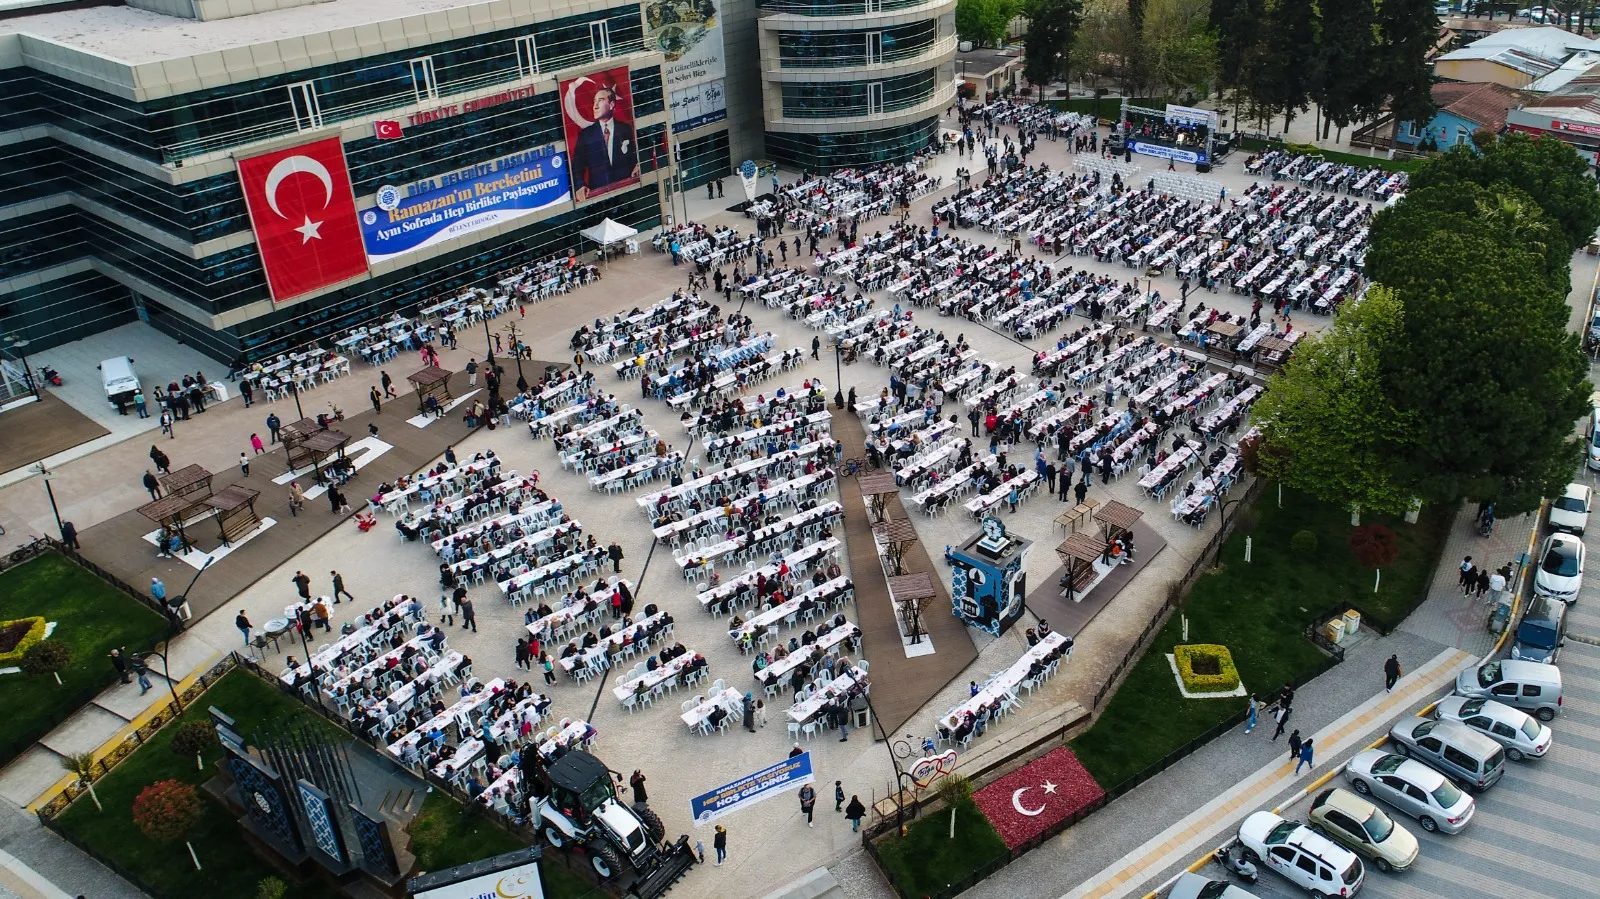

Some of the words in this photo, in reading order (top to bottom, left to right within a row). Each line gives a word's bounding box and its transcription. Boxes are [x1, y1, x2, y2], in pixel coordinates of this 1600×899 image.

[408, 104, 458, 126] TÜRKİYE
[463, 84, 536, 114] CUMHURİYETİ
[388, 189, 472, 223] Ramazan'ın
[474, 164, 542, 196] Bereketini
[408, 179, 436, 197] BİGA
[442, 164, 493, 188] BELEDİYE
[497, 144, 556, 171] BAŞKANLIĞI
[376, 227, 402, 241] Aynı
[402, 212, 443, 233] Sofrada
[444, 207, 464, 220] Hep
[465, 195, 502, 212] Birlikte
[503, 178, 559, 200] Paylaşıyoruz
[703, 796, 720, 806] HEP
[720, 781, 756, 797] BİRLİKTE
[756, 762, 800, 783] YAŞIYORUZ
[716, 793, 740, 808] HOŞ
[741, 772, 790, 797] GELDİNİZ
